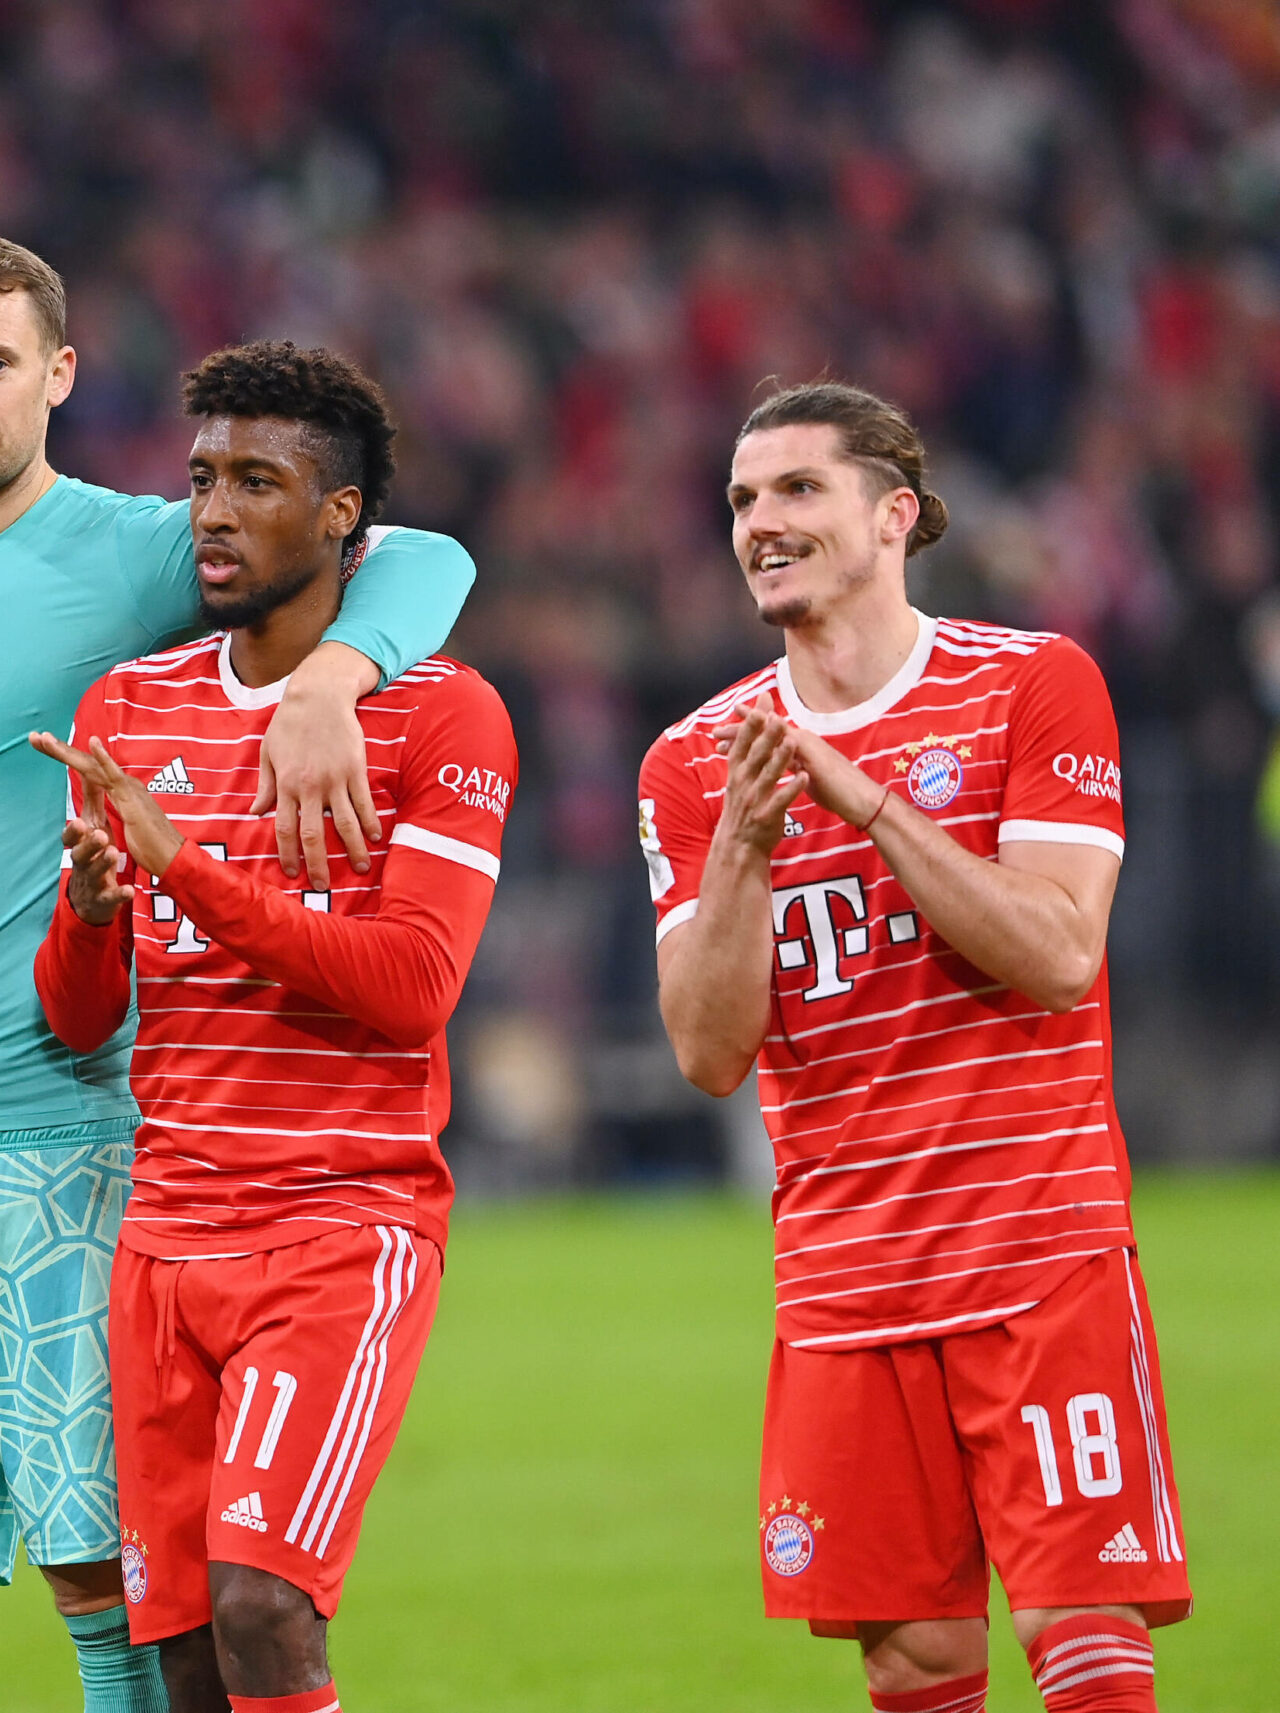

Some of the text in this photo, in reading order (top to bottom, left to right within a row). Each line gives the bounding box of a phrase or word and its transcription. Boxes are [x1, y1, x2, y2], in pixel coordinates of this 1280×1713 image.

[920, 753, 957, 773] BAYERN
[146, 778, 195, 794] adidas
[438, 763, 510, 809] QATAR
[772, 874, 868, 1003] T
[223, 1366, 298, 1470] 11
[1020, 1392, 1123, 1507] 18
[220, 1510, 269, 1533] adidas
[767, 1517, 809, 1542] FC BAYERN
[1098, 1548, 1148, 1563] adidas
